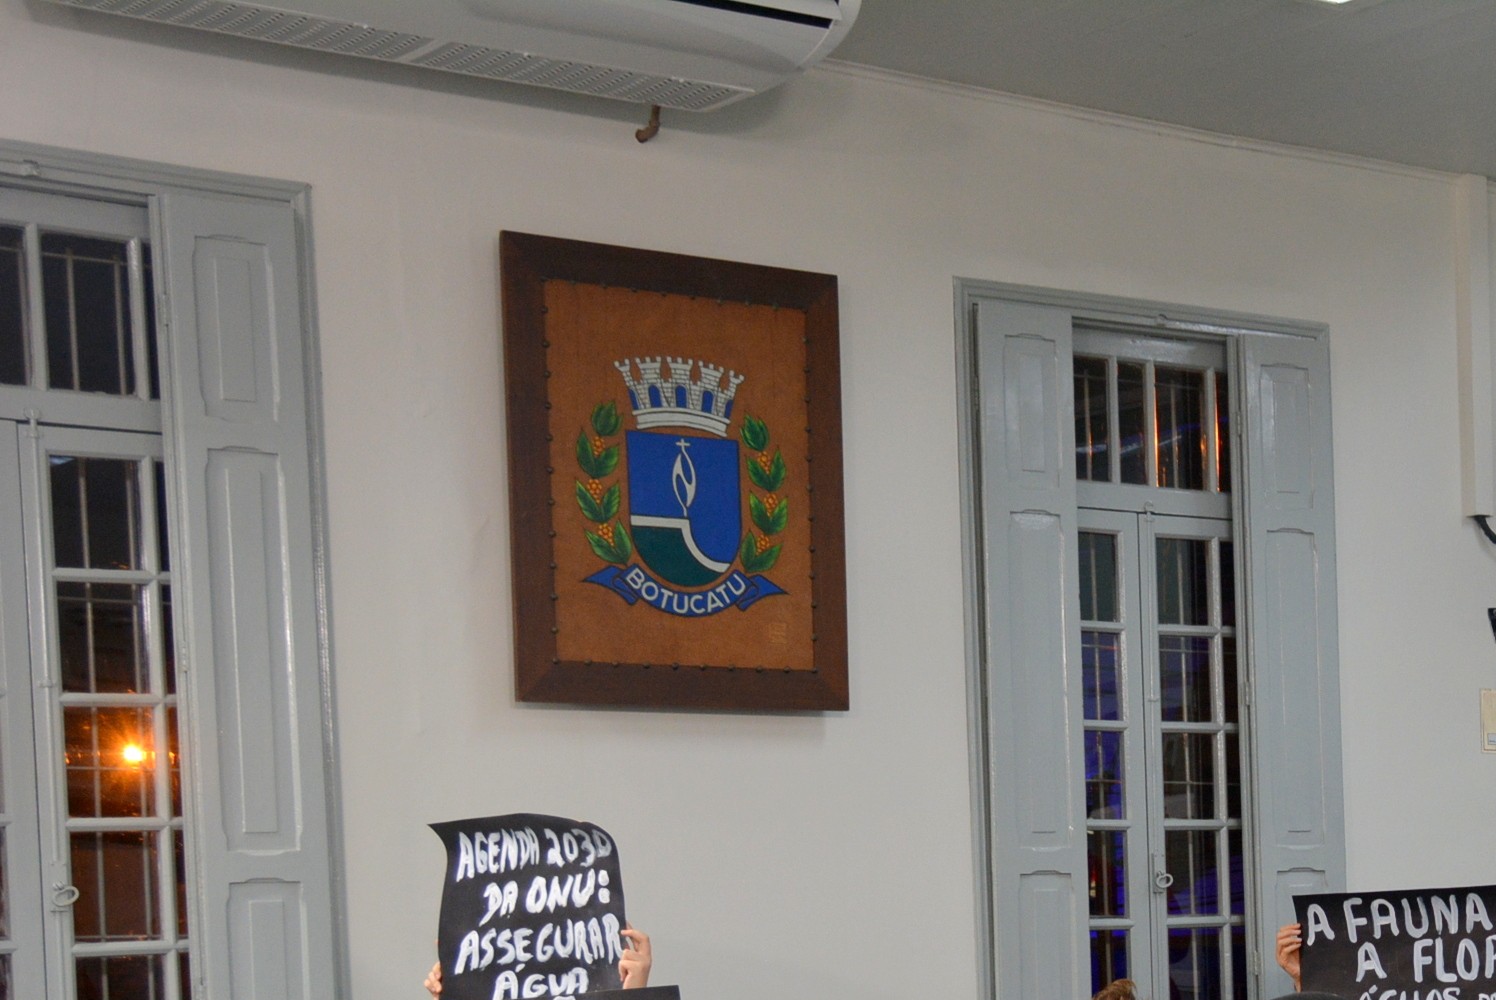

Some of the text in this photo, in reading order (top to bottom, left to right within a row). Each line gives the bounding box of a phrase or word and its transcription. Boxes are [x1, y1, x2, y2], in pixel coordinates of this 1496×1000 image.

[626, 567, 746, 614] BOTUCATU
[456, 826, 612, 882] AGENDA 2030
[479, 868, 610, 927] DA ONU:
[1306, 892, 1493, 946] A FAUNA
[454, 913, 623, 974] ASSEGURAR
[1356, 941, 1387, 983] A
